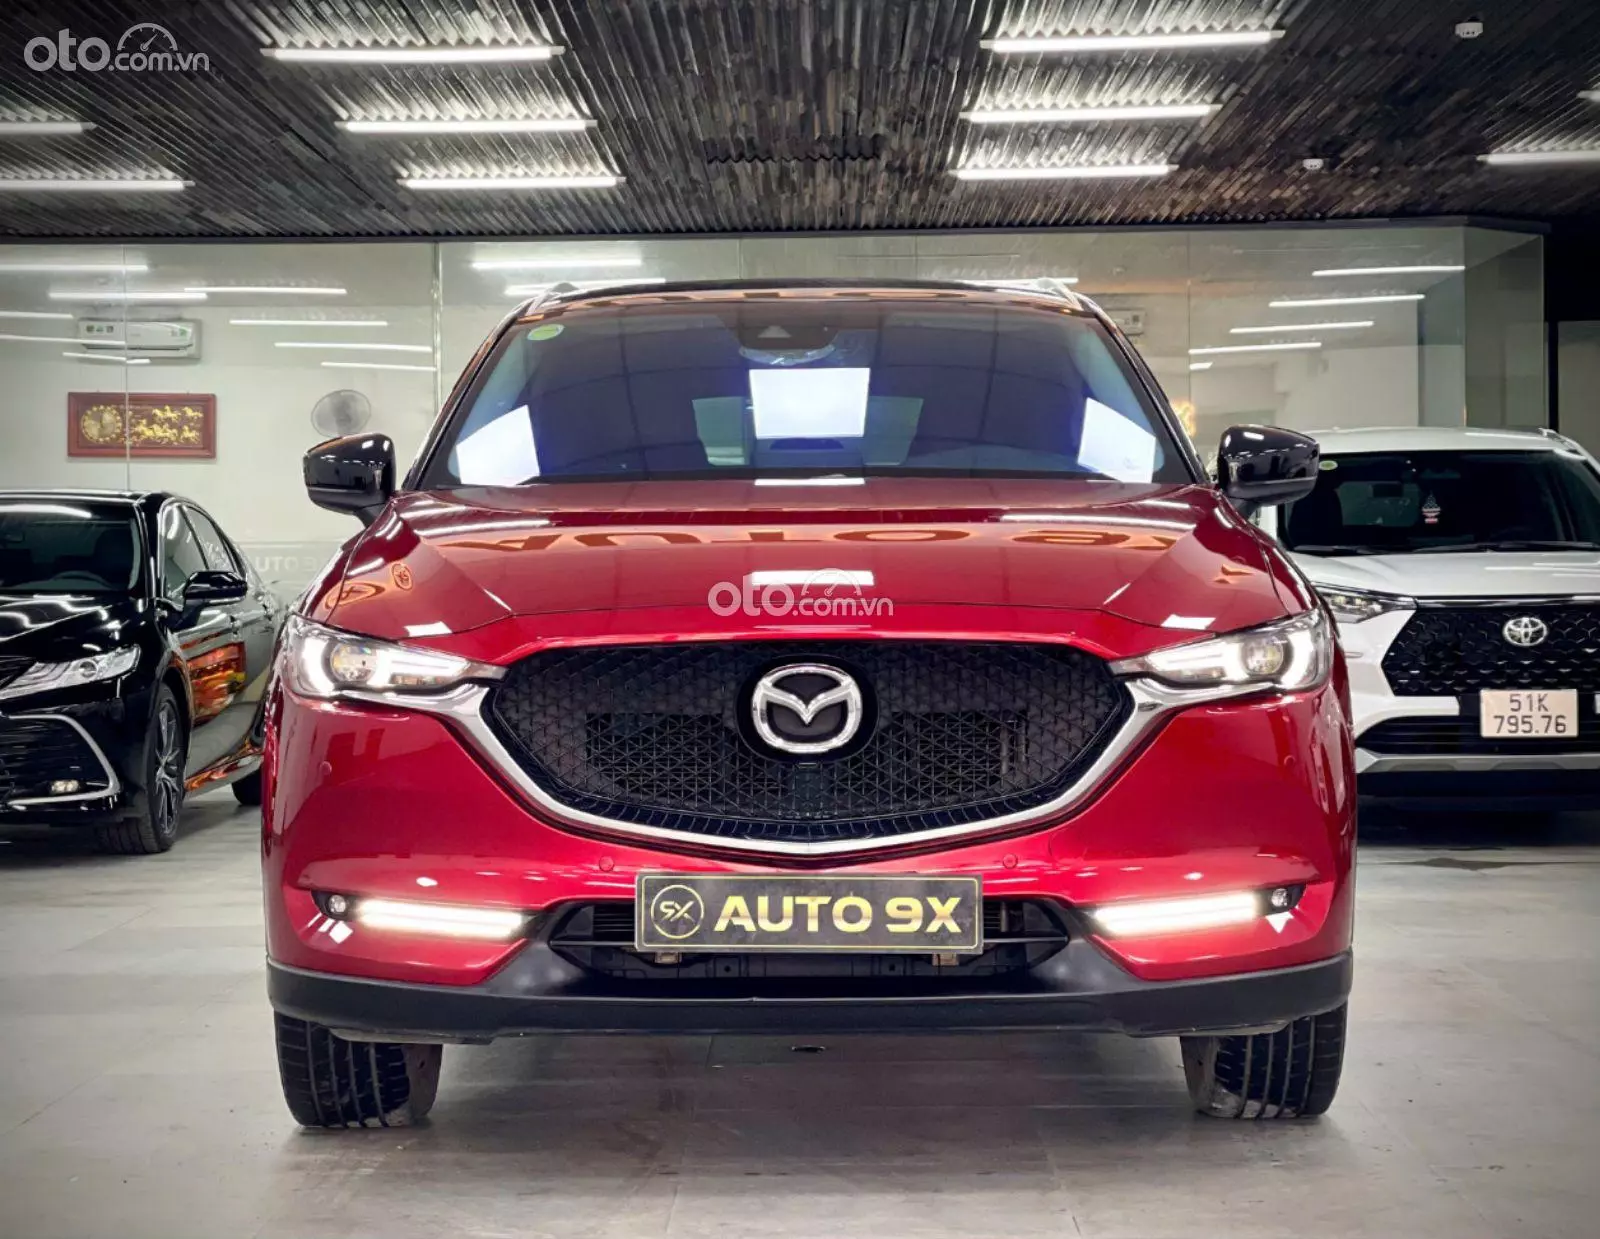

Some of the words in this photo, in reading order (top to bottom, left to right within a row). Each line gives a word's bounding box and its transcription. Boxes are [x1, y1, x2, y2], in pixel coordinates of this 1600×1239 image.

[1509, 693, 1549, 713] 51K
[1493, 714, 1567, 734] 795.76
[714, 896, 873, 933] AUTO
[885, 897, 963, 933] 9X
